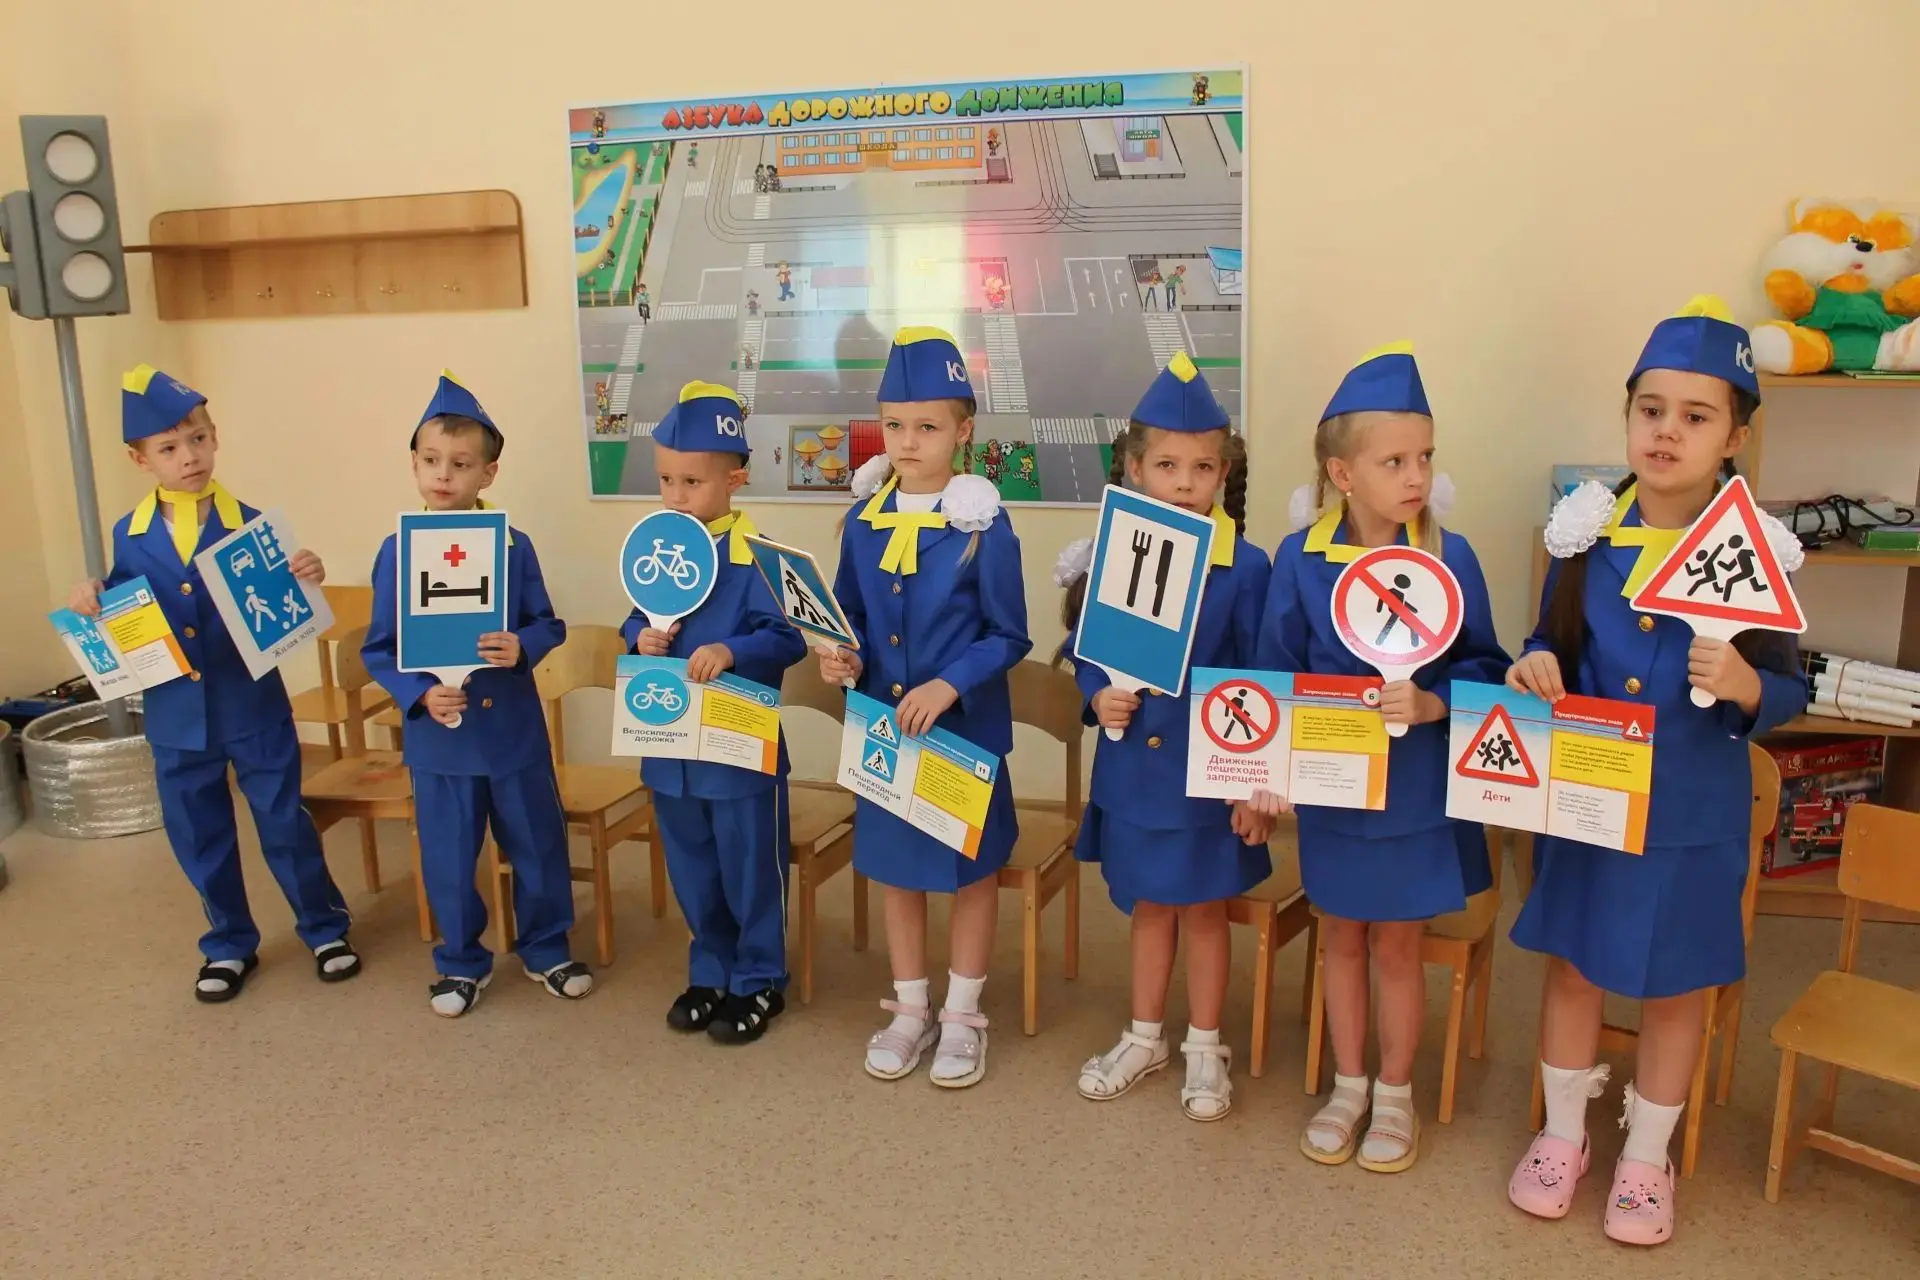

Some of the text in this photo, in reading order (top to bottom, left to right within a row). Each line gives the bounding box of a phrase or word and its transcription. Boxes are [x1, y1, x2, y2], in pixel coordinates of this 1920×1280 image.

[662, 82, 1124, 130] АЗБУКА ДОРОЖНОГО ДВИЖЕНИЯ
[945, 360, 968, 382] Ю
[623, 727, 688, 738] Велосипедная
[1631, 726, 1638, 735] 2
[634, 735, 675, 743] дорожка
[1208, 755, 1268, 767] Движение
[1206, 765, 1269, 776] пешеходов
[848, 767, 901, 801] Пешеходный
[1206, 774, 1269, 784] запрещено
[857, 780, 890, 803] переход
[1482, 790, 1511, 803] Дети
